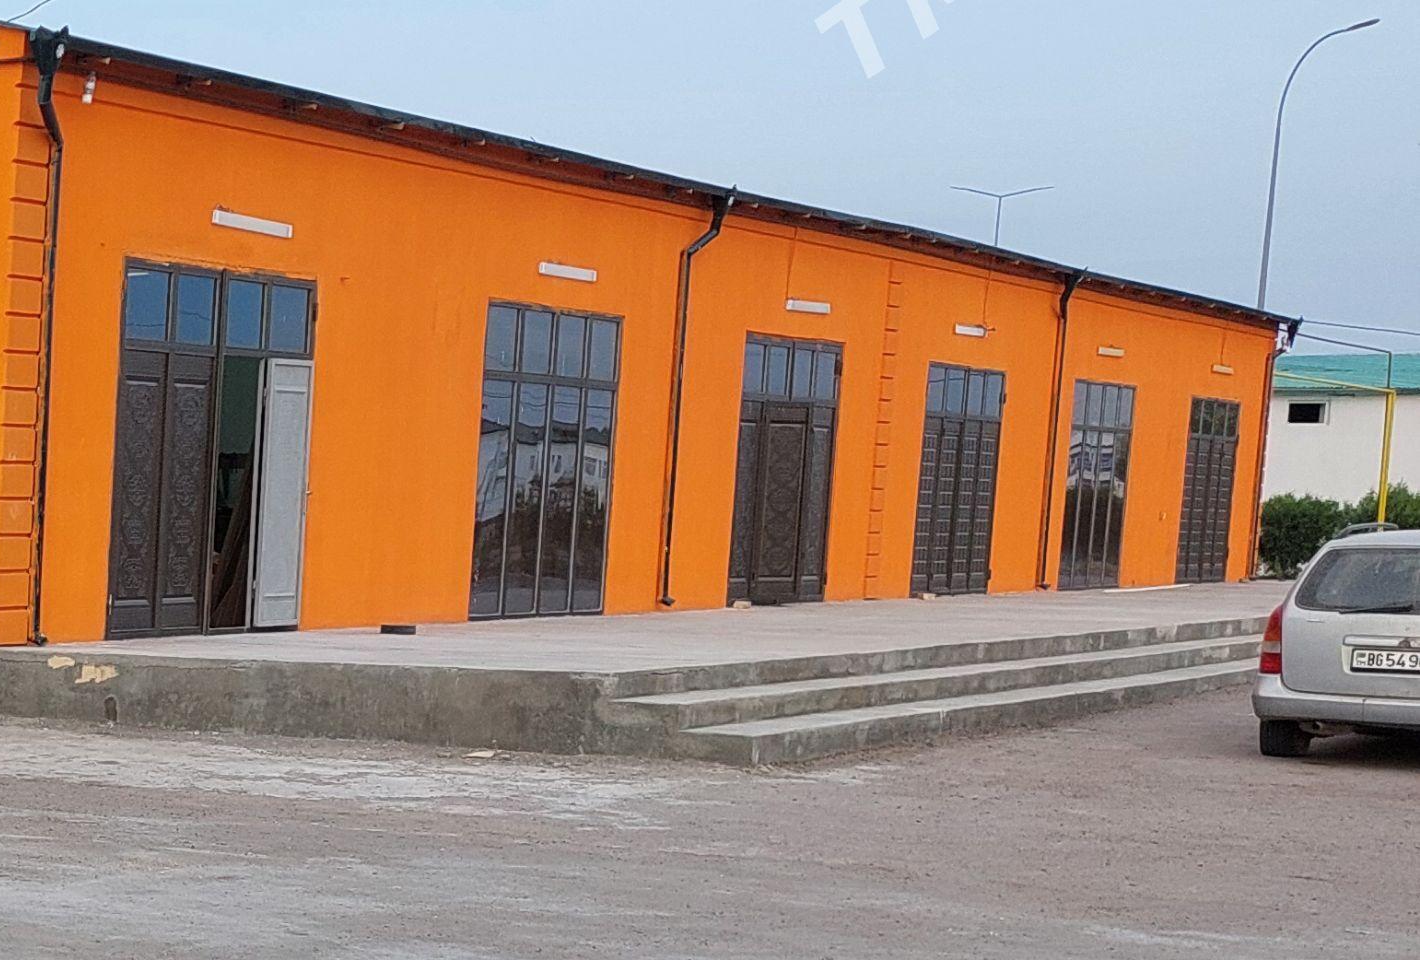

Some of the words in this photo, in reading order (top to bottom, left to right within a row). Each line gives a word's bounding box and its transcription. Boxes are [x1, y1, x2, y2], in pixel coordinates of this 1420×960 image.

[1367, 652, 1384, 667] BG
[1385, 653, 1406, 668] 54
[1408, 654, 1420, 668] 9
